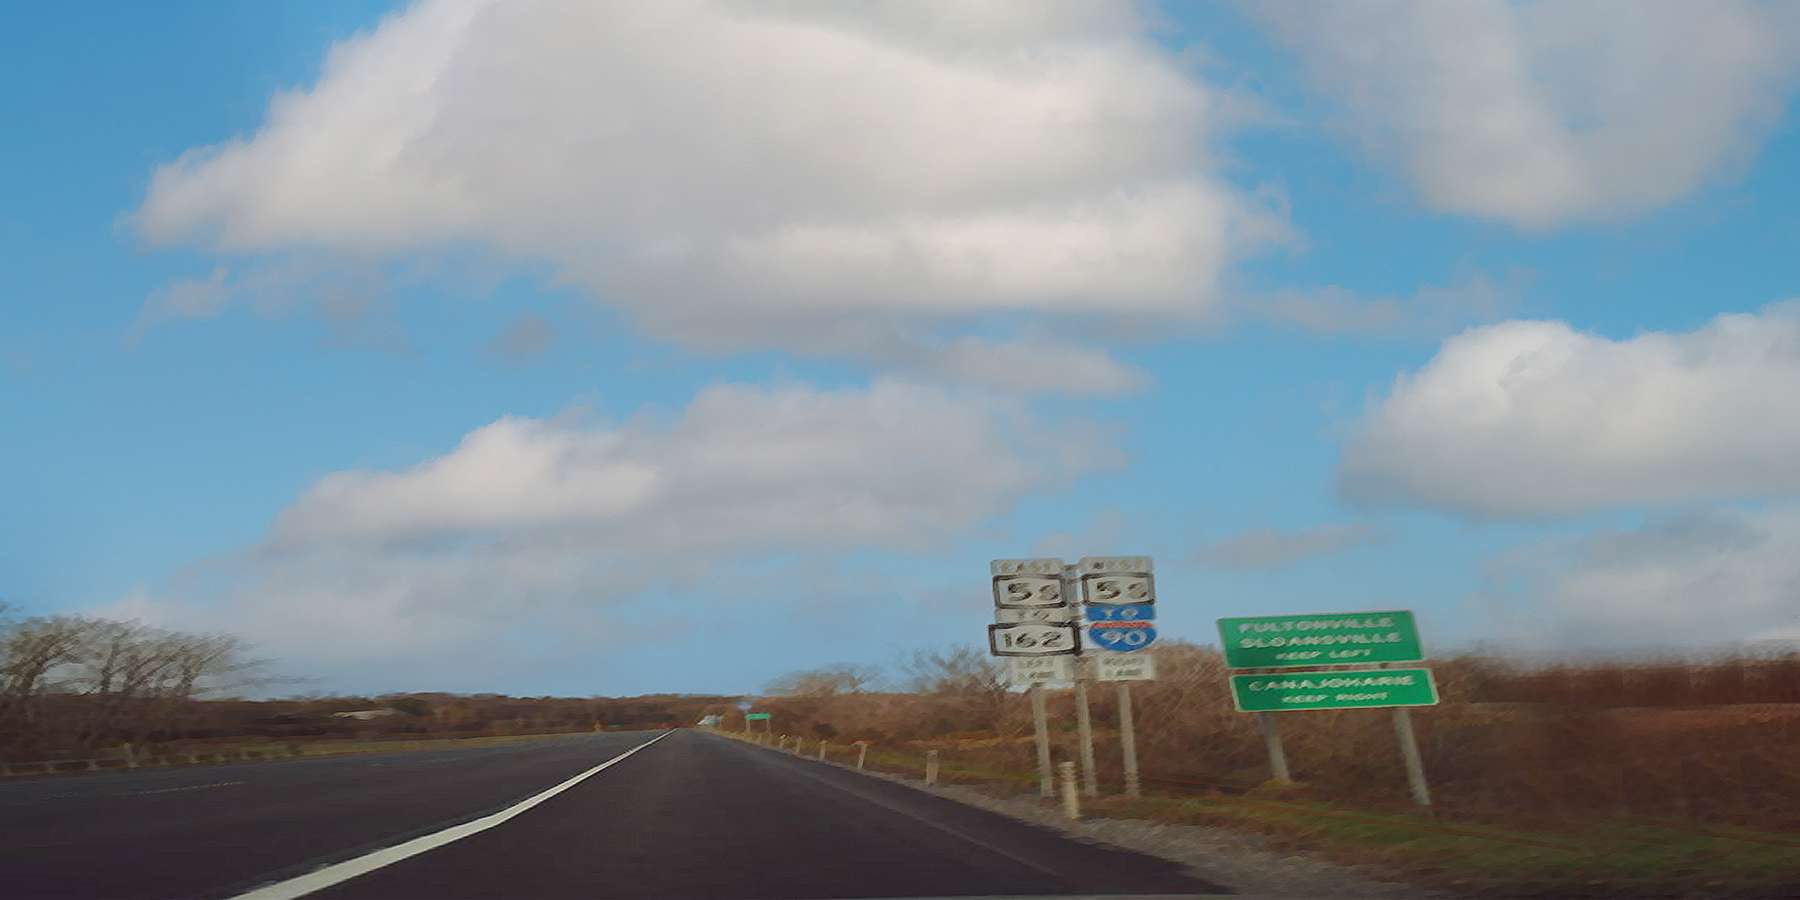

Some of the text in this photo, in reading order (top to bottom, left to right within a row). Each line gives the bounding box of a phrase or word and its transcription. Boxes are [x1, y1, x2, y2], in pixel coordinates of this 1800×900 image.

[1103, 607, 1139, 619] TO
[1237, 616, 1395, 634] FULTONVILLE
[1004, 630, 1063, 649] 162
[1102, 629, 1148, 646] 90
[1239, 632, 1402, 649] SLOANSVILLE
[1275, 648, 1372, 660] KEEP LEFT
[1247, 675, 1415, 692] CANAJOHARIE
[1281, 691, 1389, 704] KEEP RIGHT
